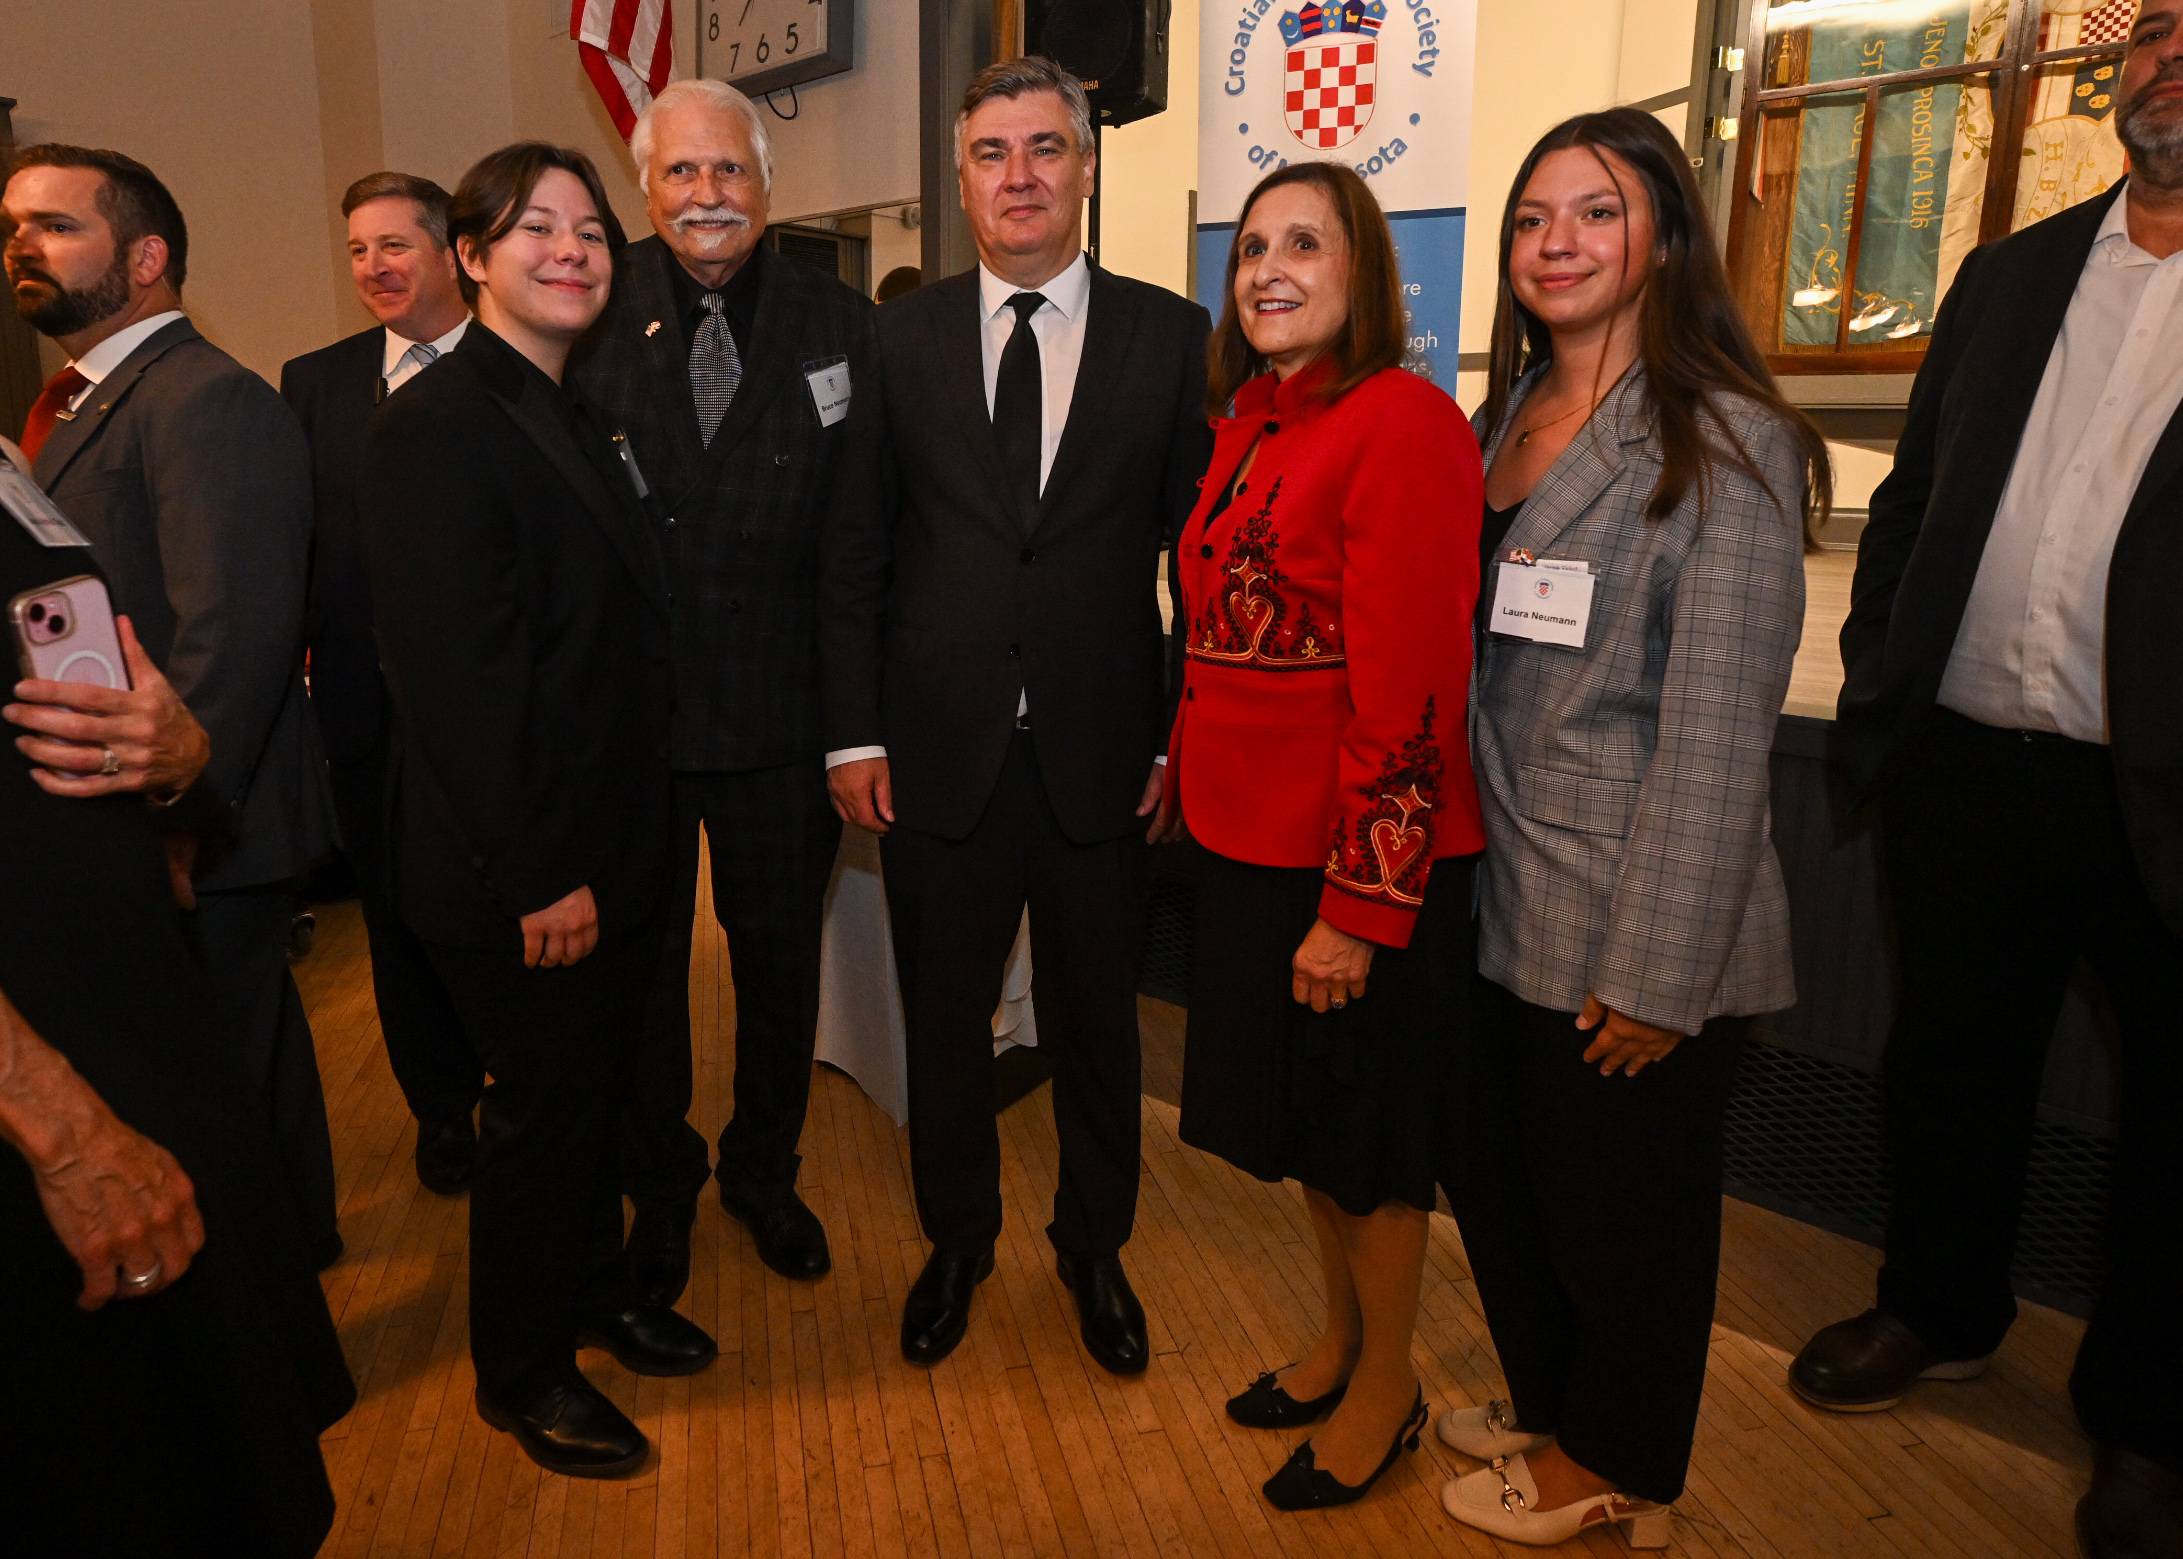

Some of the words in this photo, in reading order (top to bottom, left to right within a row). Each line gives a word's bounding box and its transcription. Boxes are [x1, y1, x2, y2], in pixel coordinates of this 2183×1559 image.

[708, 13, 720, 41] 8
[784, 22, 798, 54] 5
[1919, 16, 1949, 68] JENO
[729, 42, 741, 73] 7
[756, 33, 770, 63] 6
[1224, 0, 1275, 96] Croatia
[1406, 0, 1440, 78] ociety
[1912, 86, 1935, 185] PROSINCA
[1248, 144, 1279, 171] of
[1911, 190, 1936, 229] 1916
[1502, 606, 1529, 619] Laura
[1531, 611, 1577, 626] Neumann
